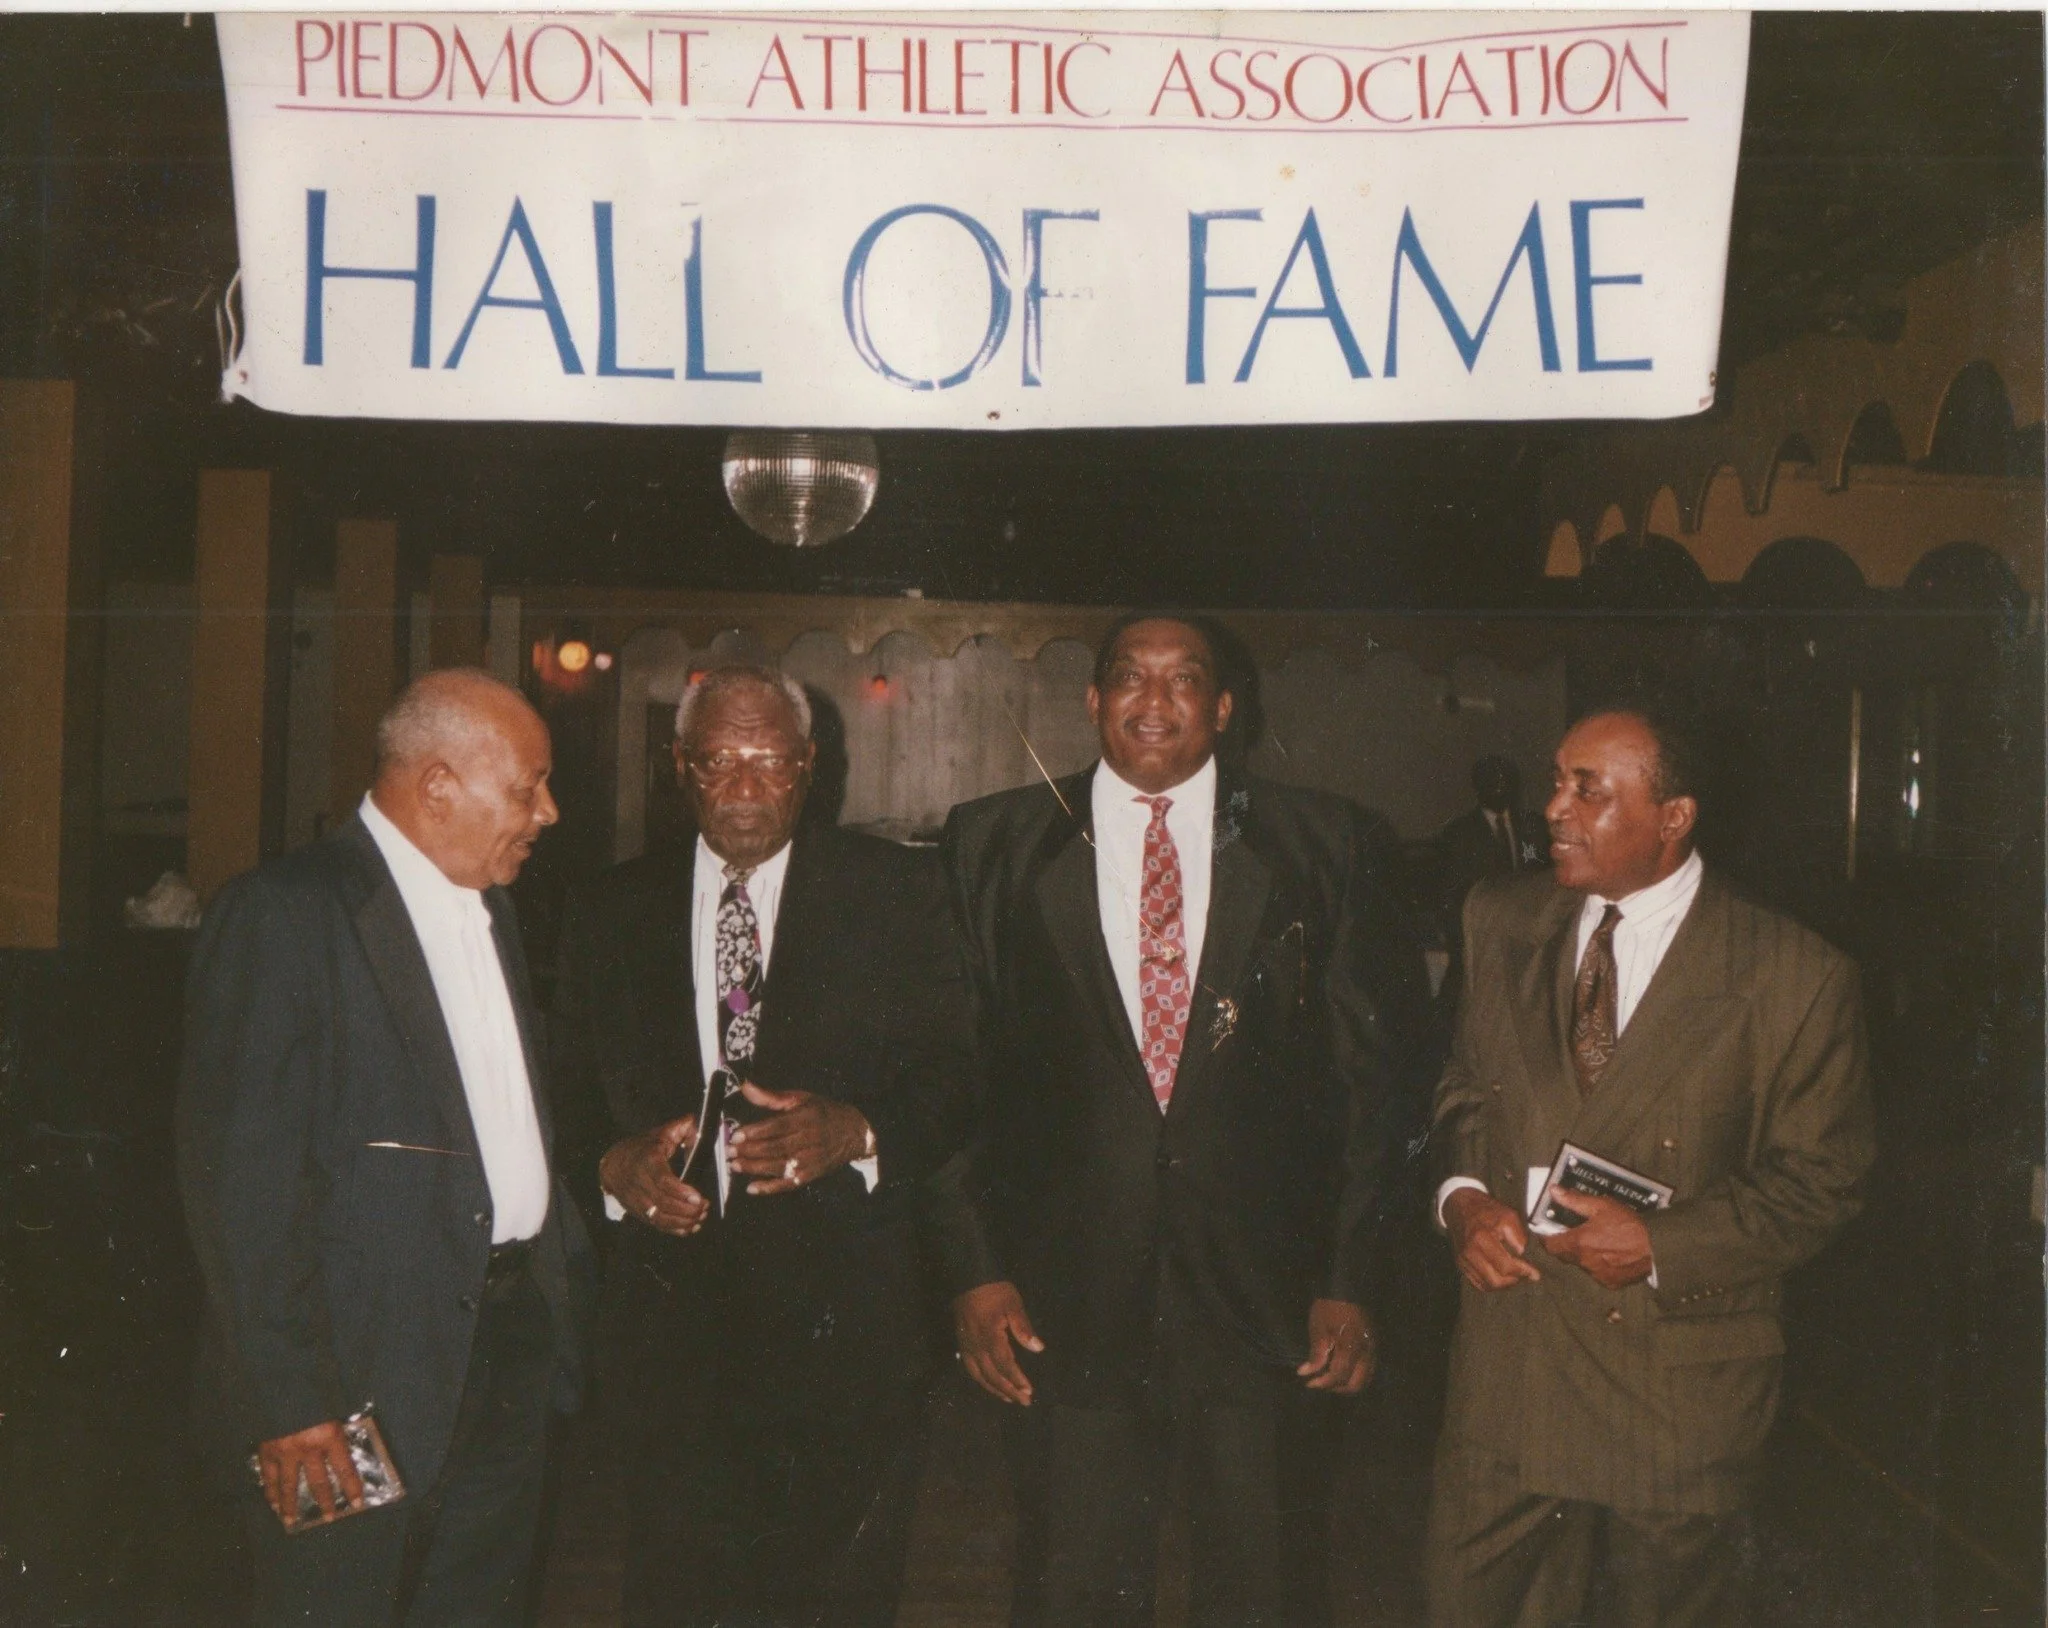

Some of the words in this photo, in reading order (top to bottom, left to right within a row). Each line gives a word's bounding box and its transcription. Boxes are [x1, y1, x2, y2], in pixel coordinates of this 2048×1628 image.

[295, 19, 709, 107] PIEDMONT
[747, 34, 1111, 119] ATHLETIC
[1149, 37, 1669, 124] ASSOCIATION
[303, 188, 762, 384] HALL
[842, 203, 1101, 391] OF
[1185, 197, 1654, 384] FAME
